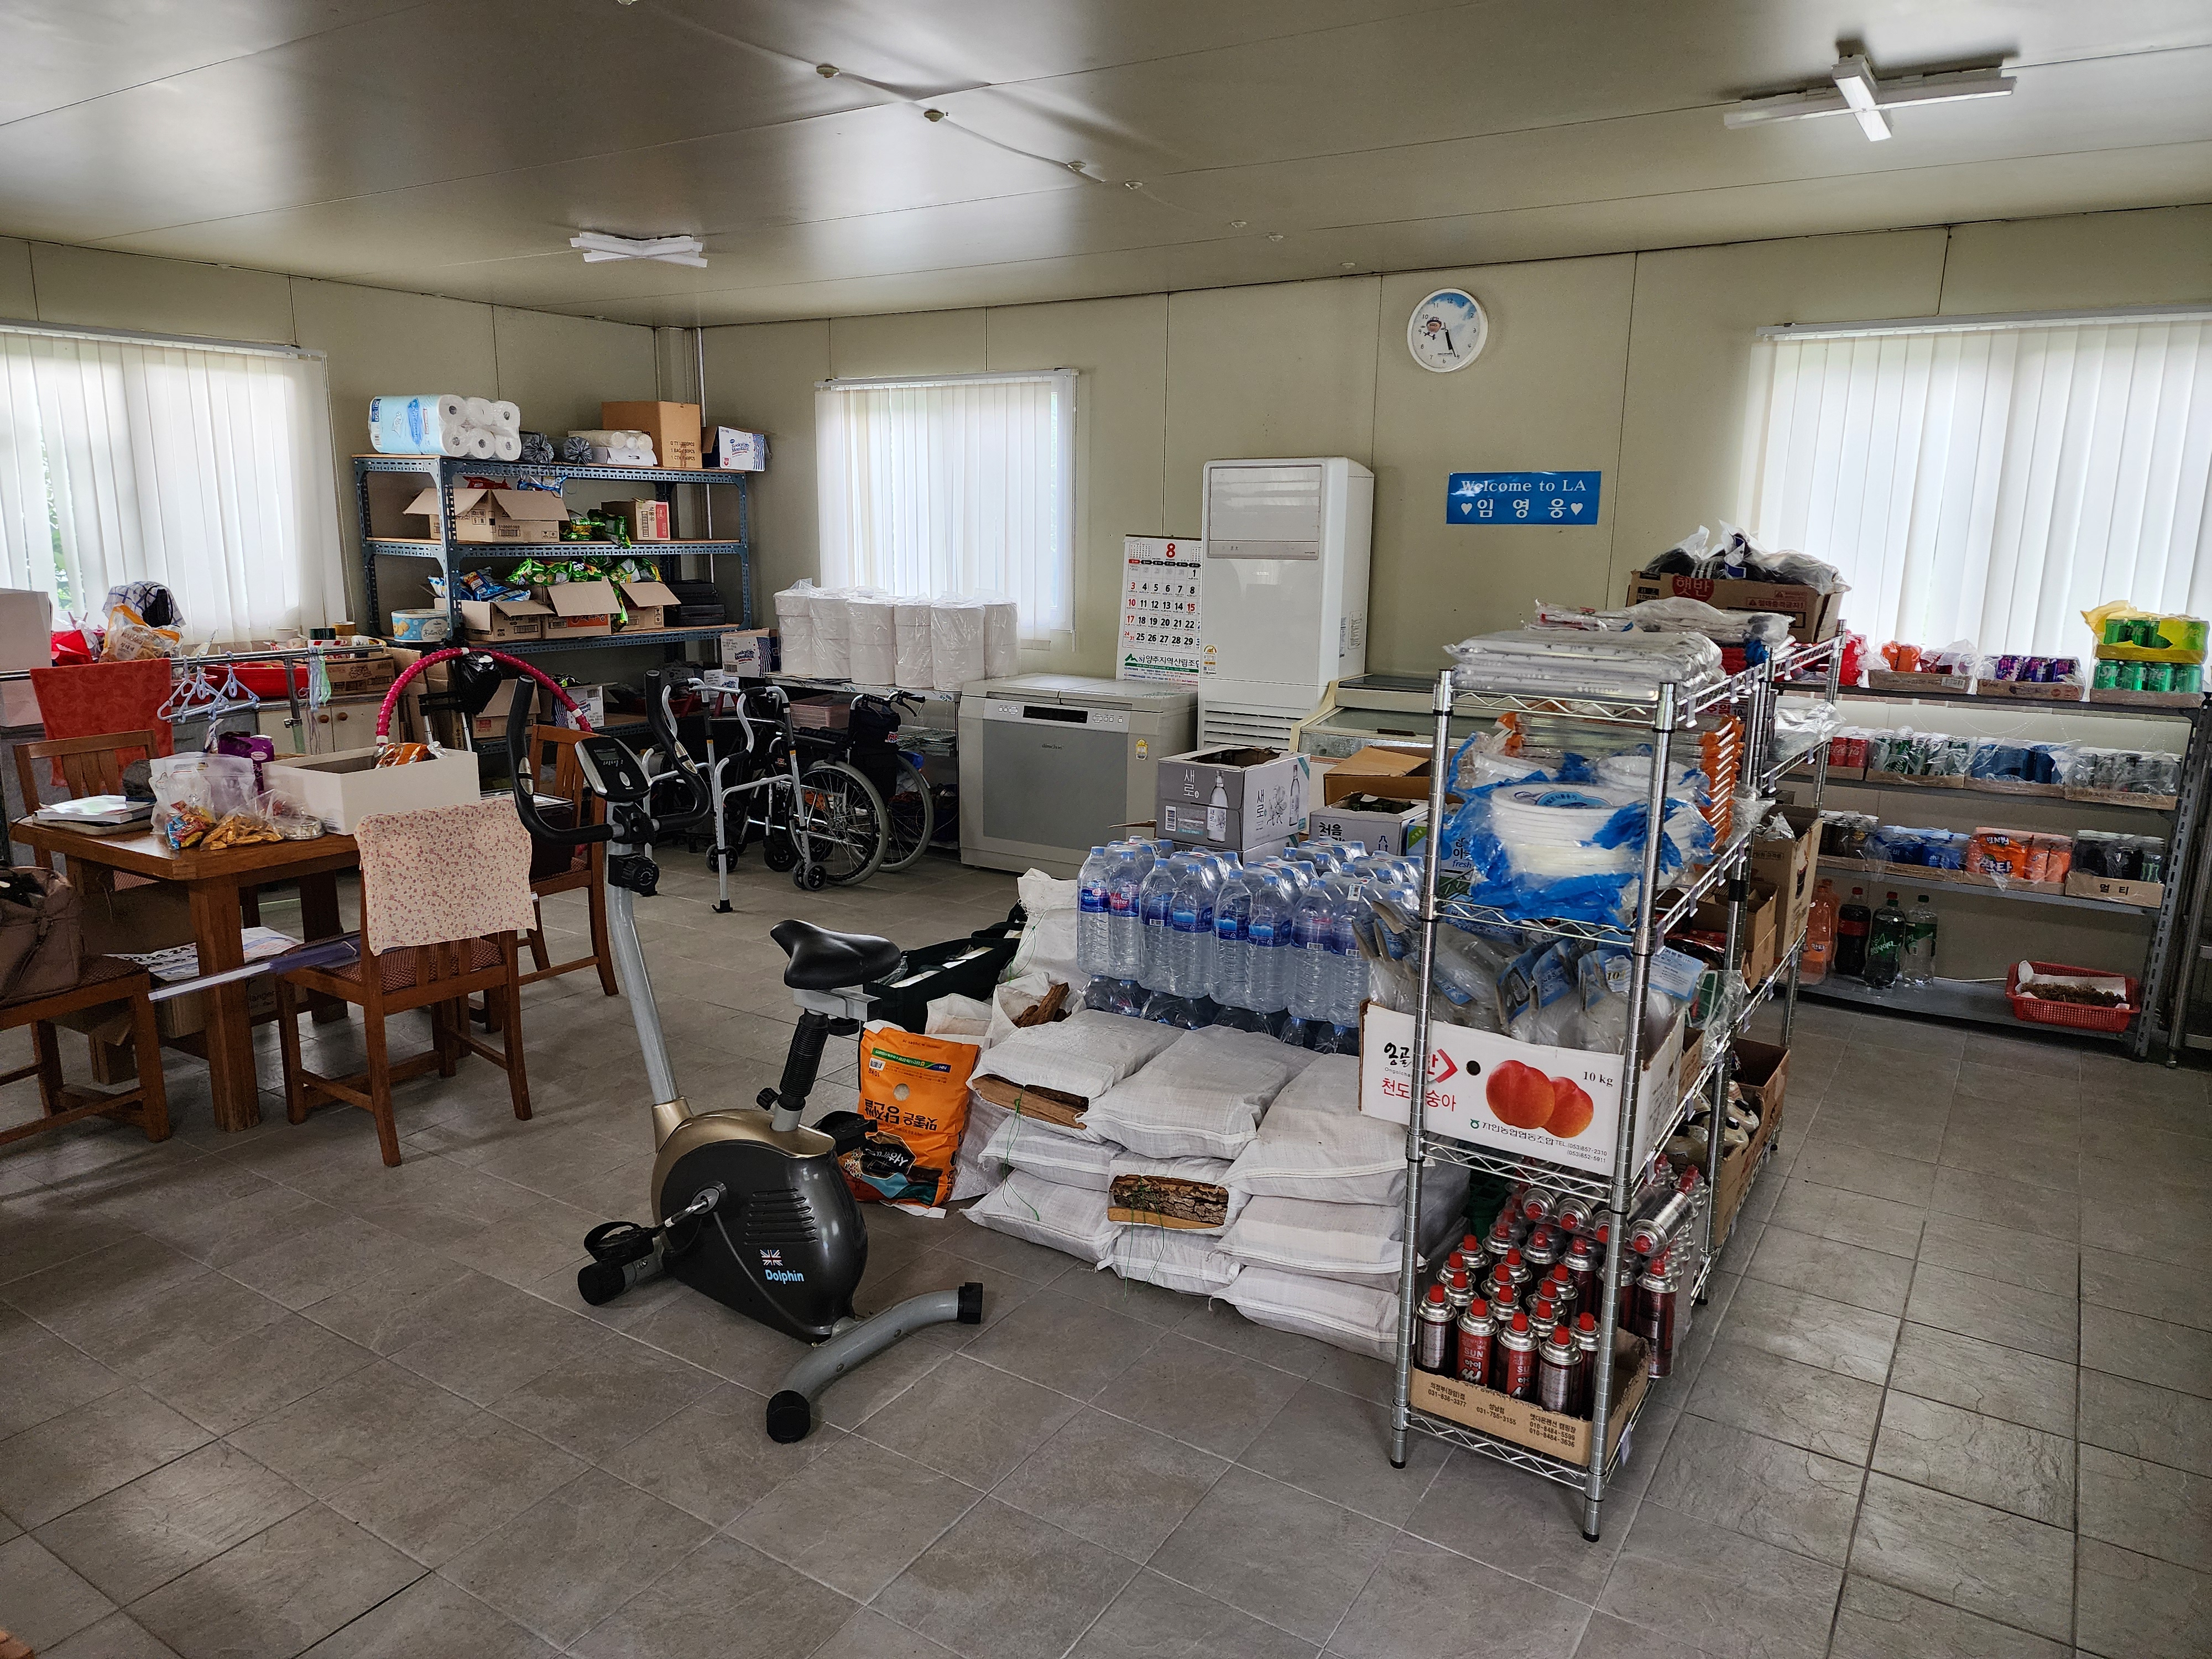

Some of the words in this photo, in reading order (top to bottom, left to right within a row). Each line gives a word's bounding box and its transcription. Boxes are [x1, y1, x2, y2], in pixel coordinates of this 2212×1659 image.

[1462, 480, 1532, 492] Welcome
[1539, 480, 1555, 492] to
[1562, 479, 1587, 492] LA
[1477, 498, 1493, 518] 임
[1512, 498, 1530, 518] 영
[1548, 498, 1567, 518] 웅
[1166, 542, 1176, 558] 8
[1192, 569, 1196, 577] 1
[1676, 577, 1709, 597] 햇반
[1128, 598, 1136, 607] 10
[1140, 599, 1147, 608] 11
[1162, 601, 1171, 609] 13
[1175, 602, 1183, 611] 14
[1187, 603, 1196, 612] 15
[1127, 615, 1135, 623] 17
[1150, 617, 1157, 625] 19
[1173, 619, 1182, 628] 21
[1185, 620, 1194, 628] 22
[1136, 633, 1145, 641] 25
[1147, 634, 1157, 642] 26
[1171, 636, 1181, 644] 28
[1183, 637, 1193, 645] 29
[1183, 768, 1196, 798] 새로
[1255, 789, 1265, 818] 새로
[1318, 821, 1343, 837] 처음
[1452, 859, 1473, 869] fresh
[1583, 1071, 1596, 1082] 10
[1599, 1074, 1614, 1087] kg
[1382, 1077, 1457, 1112] 천도숭아
[902, 1112, 938, 1131] 맛좋은
[1482, 1121, 1554, 1146] 자인농업협동조합
[1567, 1142, 1608, 1157] (053)857-2310
[765, 1269, 805, 1285] Dolphin
[1464, 1347, 1484, 1358] SUN
[1464, 1359, 1481, 1370] 하이
[1489, 1402, 1505, 1415] 성남점
